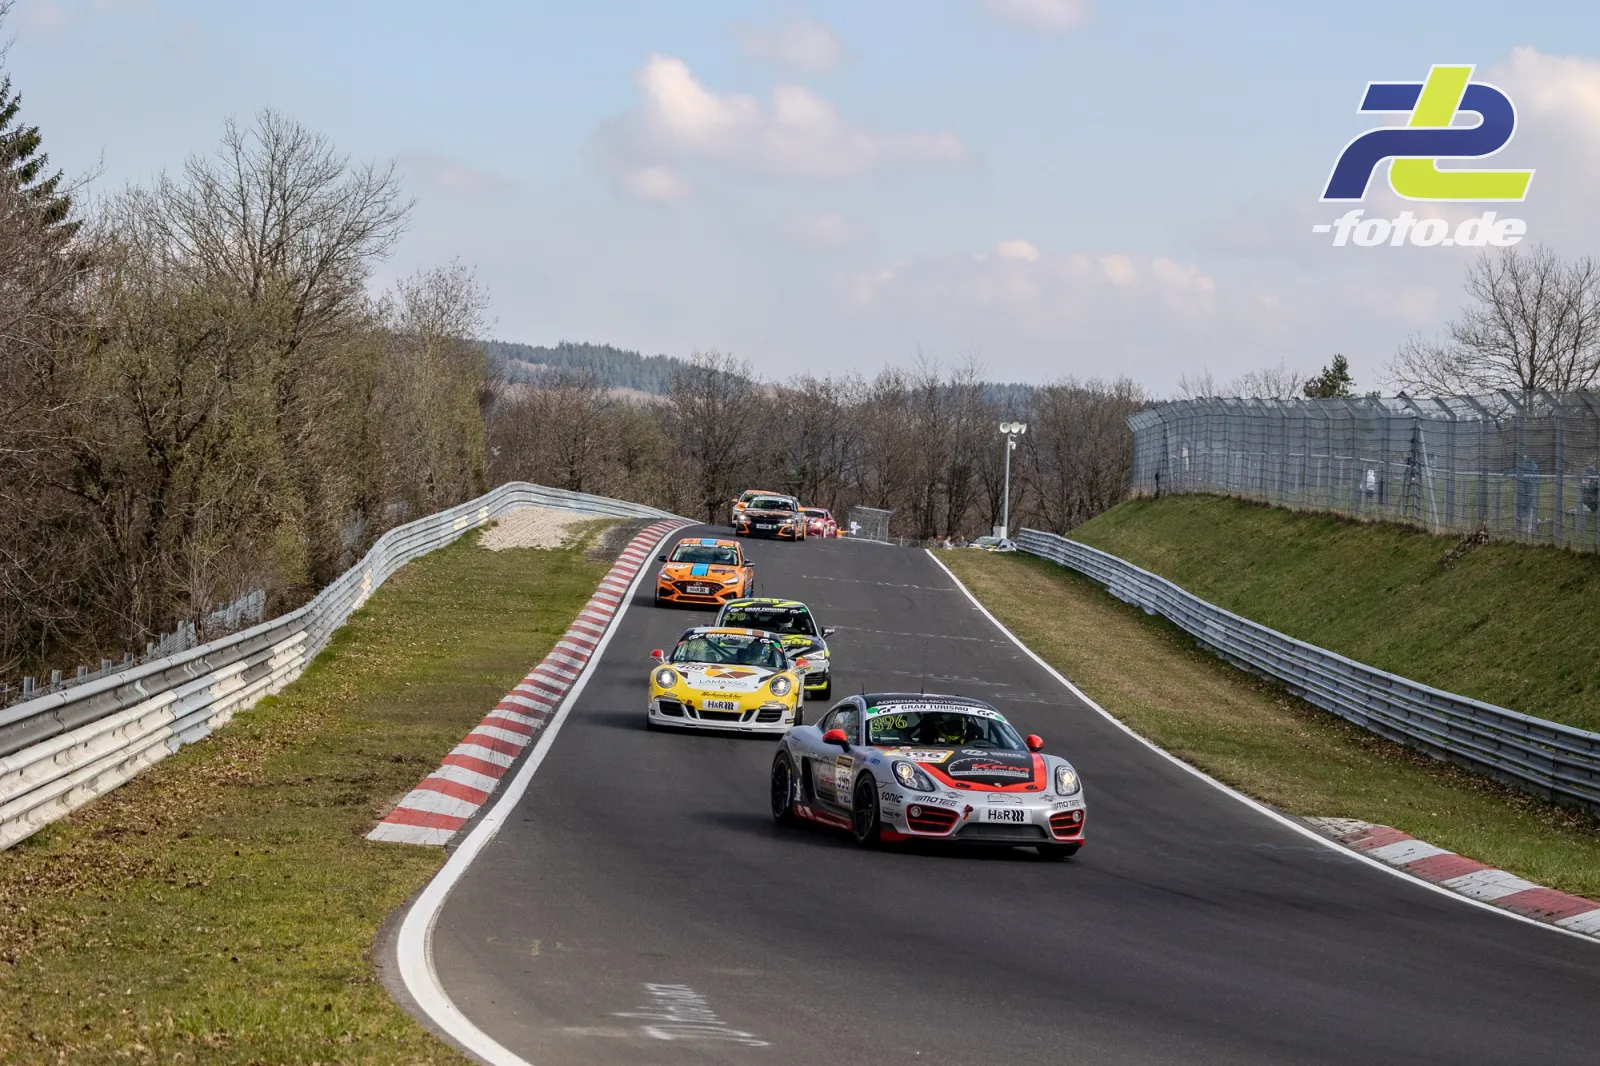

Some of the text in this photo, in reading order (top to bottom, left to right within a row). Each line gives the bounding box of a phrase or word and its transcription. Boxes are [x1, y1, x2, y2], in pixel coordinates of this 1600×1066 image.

[929, 704, 969, 712] TURISMO
[871, 715, 908, 732] 396
[988, 810, 1011, 820] H&R
